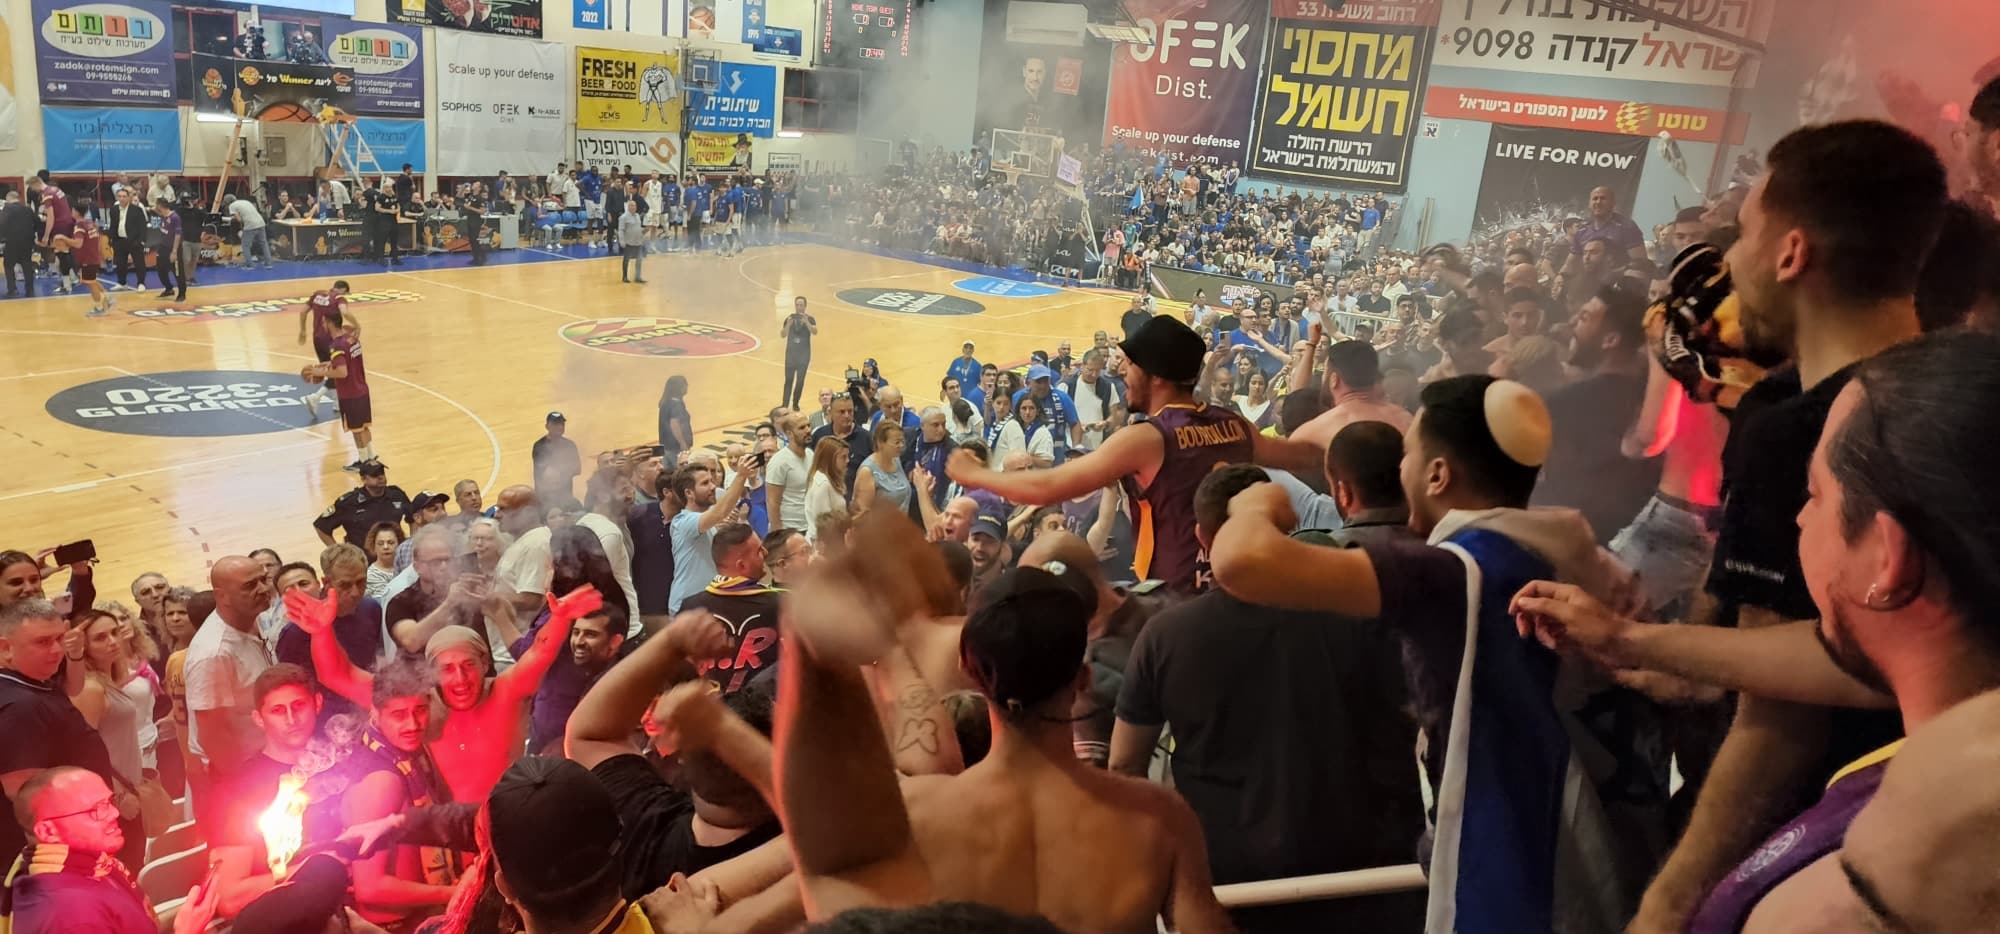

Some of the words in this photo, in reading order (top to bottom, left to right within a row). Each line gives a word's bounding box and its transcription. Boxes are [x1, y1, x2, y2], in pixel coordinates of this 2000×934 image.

[581, 10, 599, 24] 2022
[1296, 3, 1318, 17] 33
[1321, 3, 1373, 19] משכת
[56, 12, 147, 36] רותם
[339, 37, 404, 56] רותם
[1283, 27, 1416, 82] מחסני
[1548, 33, 1639, 72] קנדה
[1641, 32, 1740, 72] שראל
[448, 63, 476, 75] Scale
[479, 67, 491, 79] up
[494, 68, 515, 79] your
[517, 68, 554, 80] defense
[581, 57, 636, 80] FRESH
[279, 74, 314, 85] Winner
[581, 78, 604, 89] BEER
[611, 80, 636, 91] FOOD
[1155, 74, 1212, 100] Dist.
[441, 102, 482, 113] SOPHOS
[492, 103, 520, 115] OFEK
[705, 96, 760, 113] שיתופית
[1271, 74, 1410, 136] חשמל
[1459, 93, 1510, 113] בישראל
[1513, 101, 1568, 118] הספורט
[719, 116, 744, 127] לבניה
[1571, 105, 1609, 122] למען
[1657, 112, 1708, 131] טוטו
[746, 118, 771, 129] חברה
[1112, 125, 1142, 139] Scale
[1145, 131, 1159, 144] up
[1163, 133, 1189, 144] your
[1192, 133, 1240, 148] defense
[1287, 134, 1326, 151] הזולה
[578, 137, 648, 161] מטרופולין
[1328, 139, 1372, 156] הרשת
[1496, 142, 1536, 160] LIVE
[1539, 146, 1577, 164] FOR
[1583, 151, 1634, 170] NOW
[1262, 147, 1315, 168] בישראל
[1316, 153, 1396, 176] והמשתלמת
